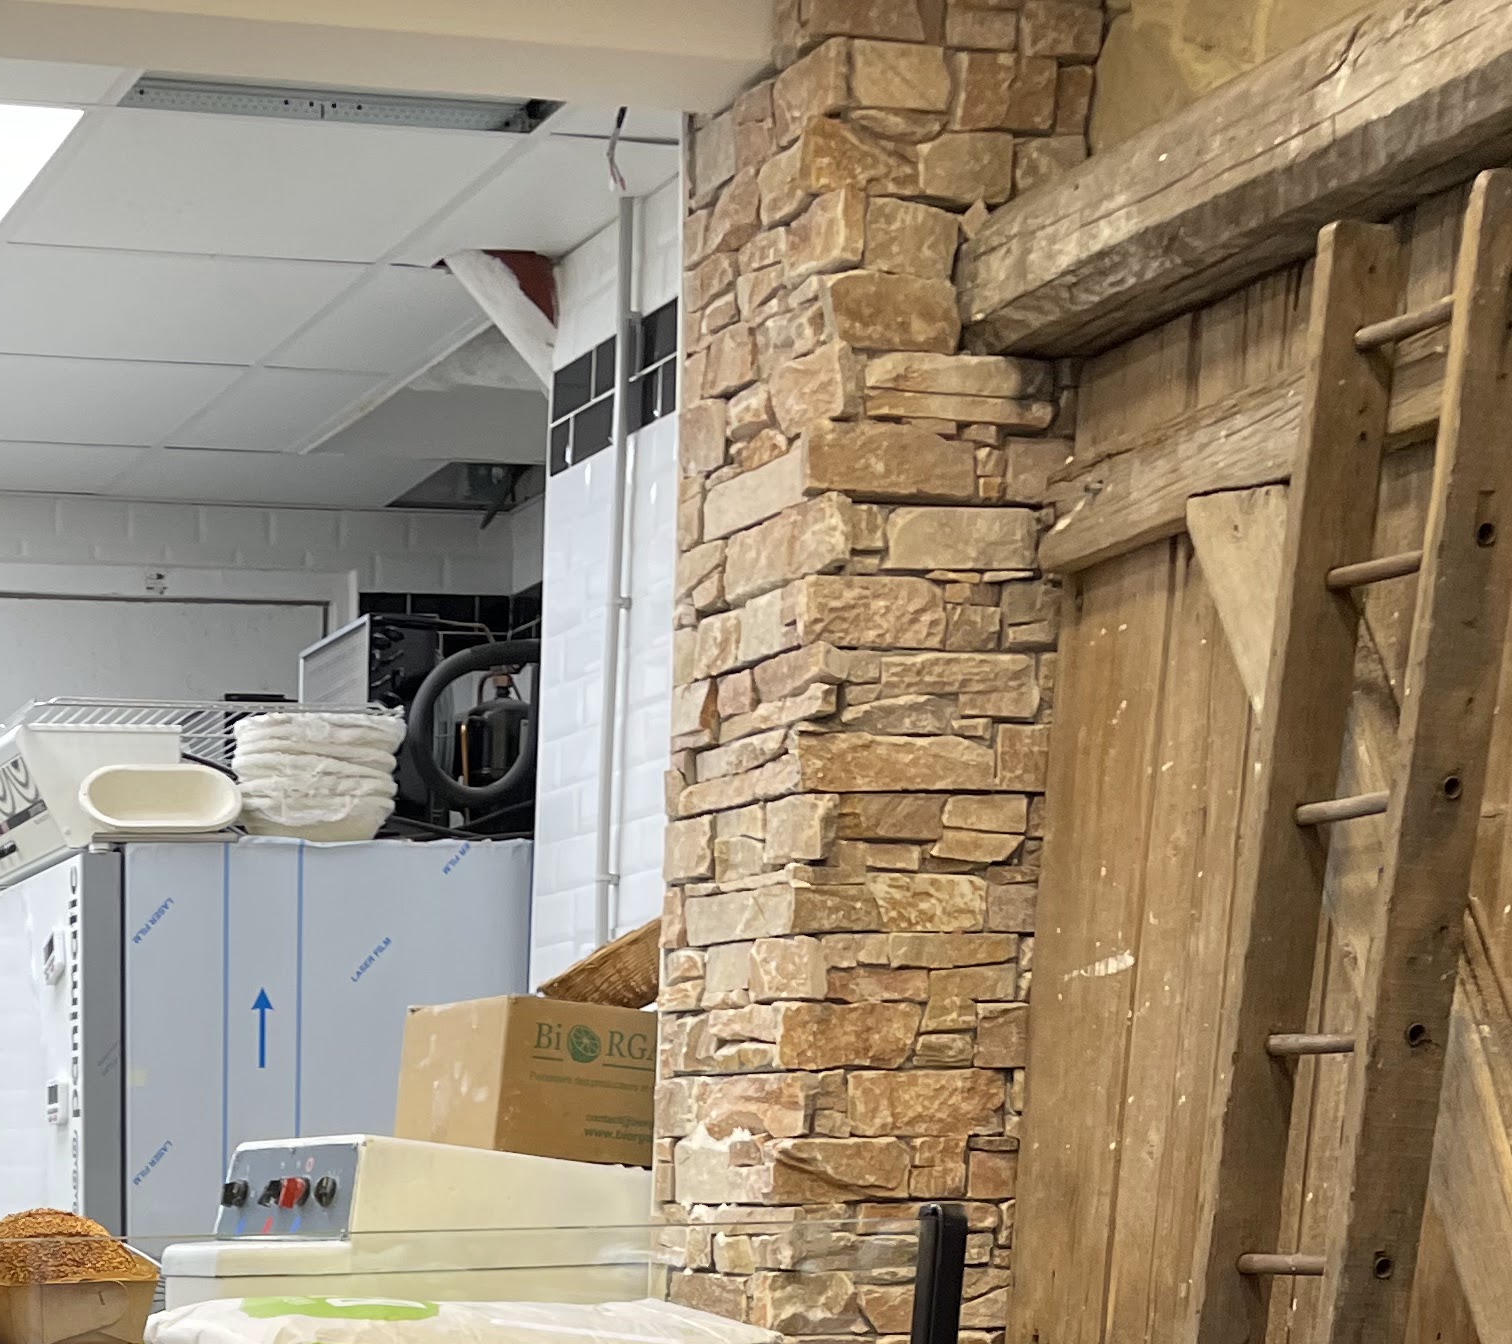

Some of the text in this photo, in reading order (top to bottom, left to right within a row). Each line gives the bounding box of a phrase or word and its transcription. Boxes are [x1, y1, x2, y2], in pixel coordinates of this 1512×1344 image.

[148, 897, 174, 925] LASER
[350, 937, 392, 983] LASER FILM
[148, 1140, 174, 1168] LASER
